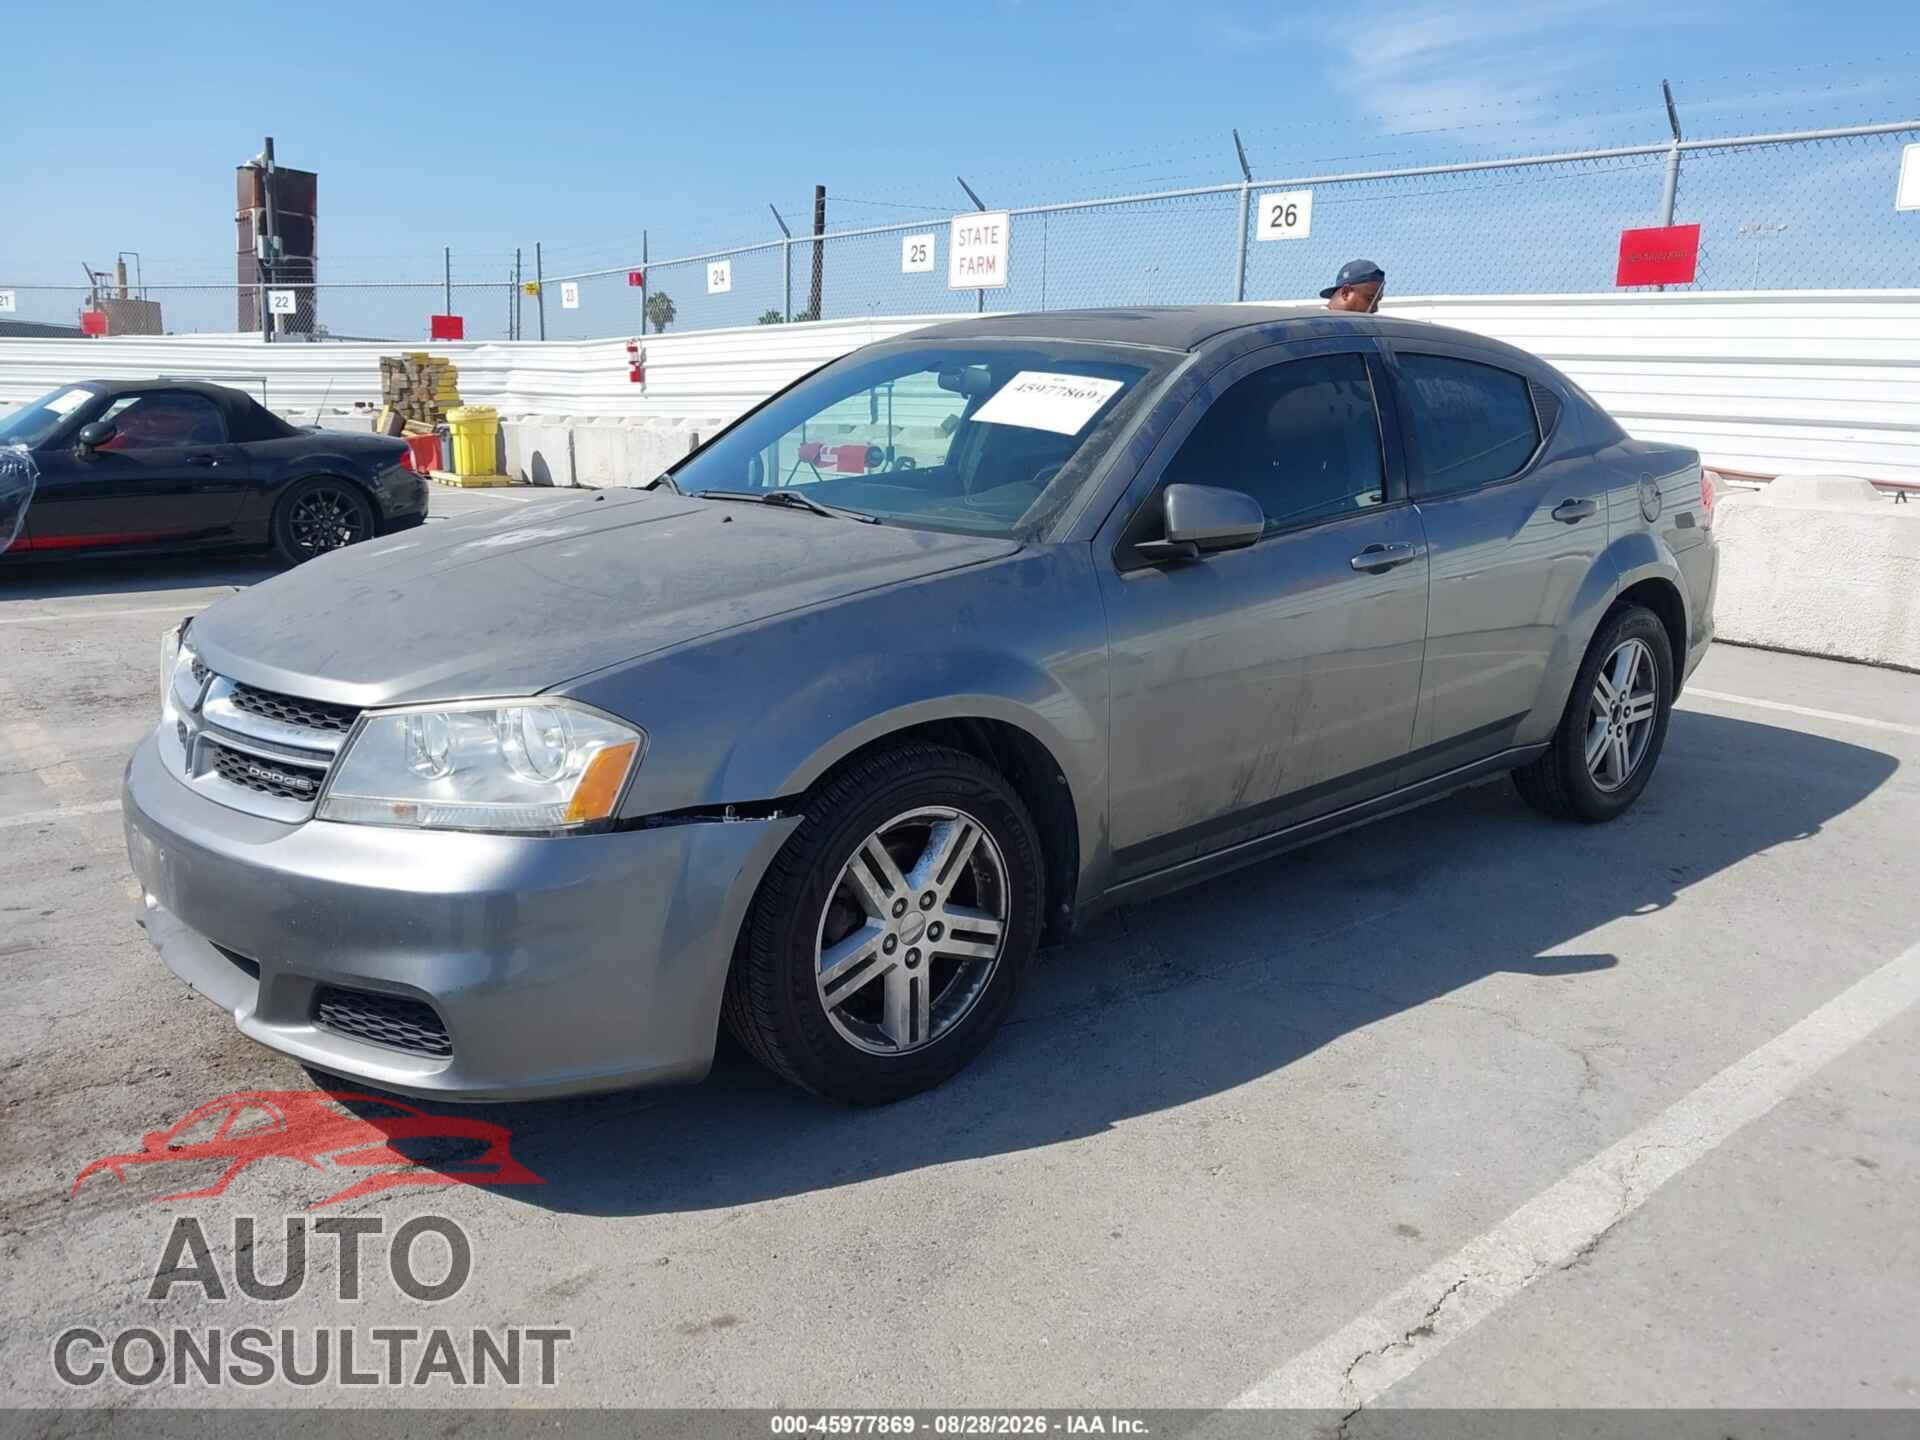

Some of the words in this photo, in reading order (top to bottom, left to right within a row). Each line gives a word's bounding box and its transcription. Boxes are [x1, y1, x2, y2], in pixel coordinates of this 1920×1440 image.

[1270, 203, 1297, 228] 26
[958, 225, 1001, 247] STATE
[910, 244, 927, 263] 25
[959, 255, 996, 276] FARM
[712, 269, 725, 286] 24
[274, 295, 289, 308] 22
[249, 766, 313, 791] DODGE
